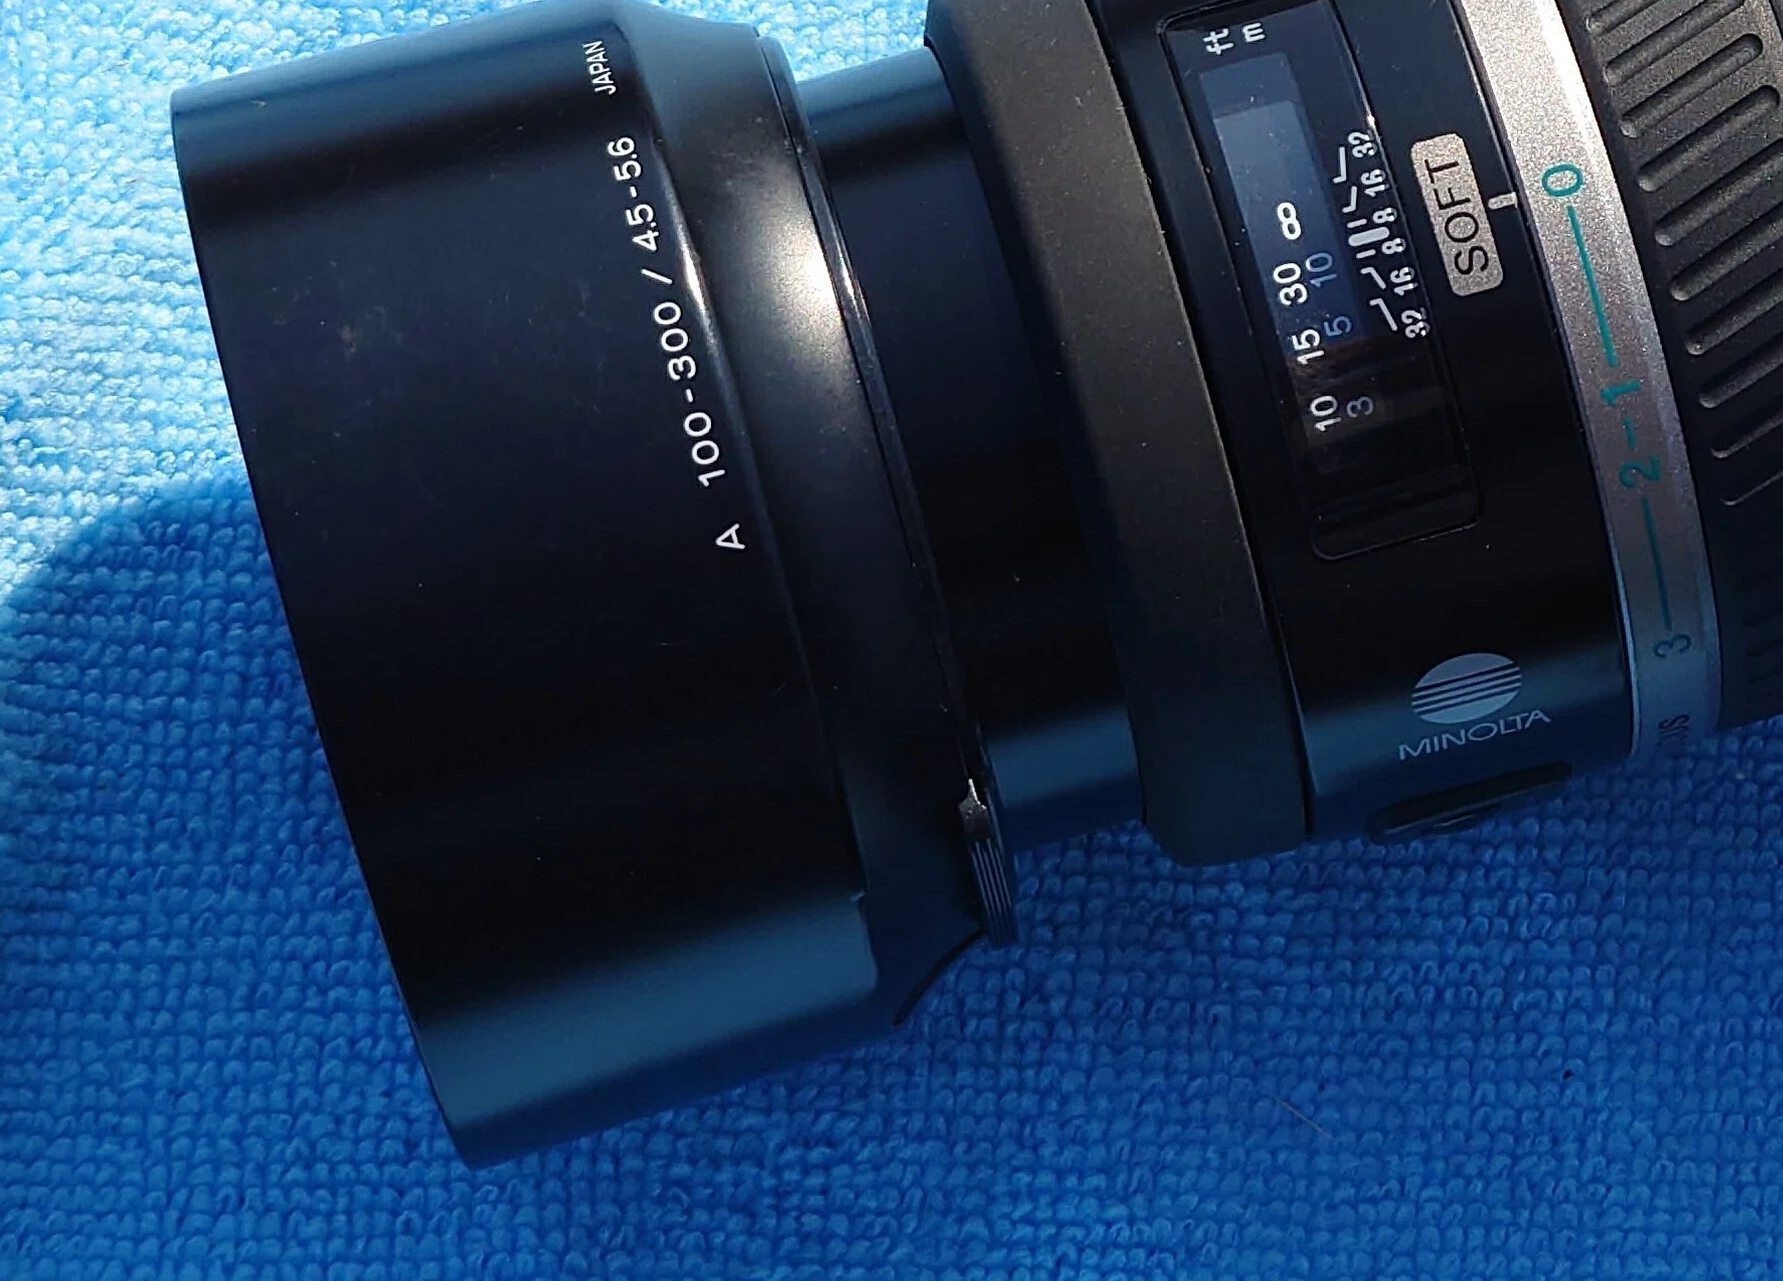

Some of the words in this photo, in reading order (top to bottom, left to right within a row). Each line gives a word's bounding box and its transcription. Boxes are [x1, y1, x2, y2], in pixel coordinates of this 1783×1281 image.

[1203, 27, 1234, 55] ft
[1242, 22, 1266, 43] m
[582, 40, 617, 95] JAPAN
[1360, 168, 1390, 197] 16
[1540, 163, 1584, 197] 0
[1373, 207, 1398, 224] 8
[1424, 159, 1489, 275] SOFT
[1381, 237, 1407, 255] 8
[1273, 262, 1308, 306] 30
[1305, 252, 1338, 288] 10
[1390, 266, 1419, 296] 16
[1324, 315, 1352, 337] 5
[1292, 328, 1325, 366] 15
[653, 301, 726, 487] 100-300
[1346, 396, 1374, 418] 3
[1600, 380, 1641, 407] 1
[1310, 395, 1342, 432] 10
[1618, 455, 1661, 489] 2
[715, 523, 746, 550] A
[1653, 633, 1692, 658] 3
[1399, 709, 1551, 760] MINOLTA
